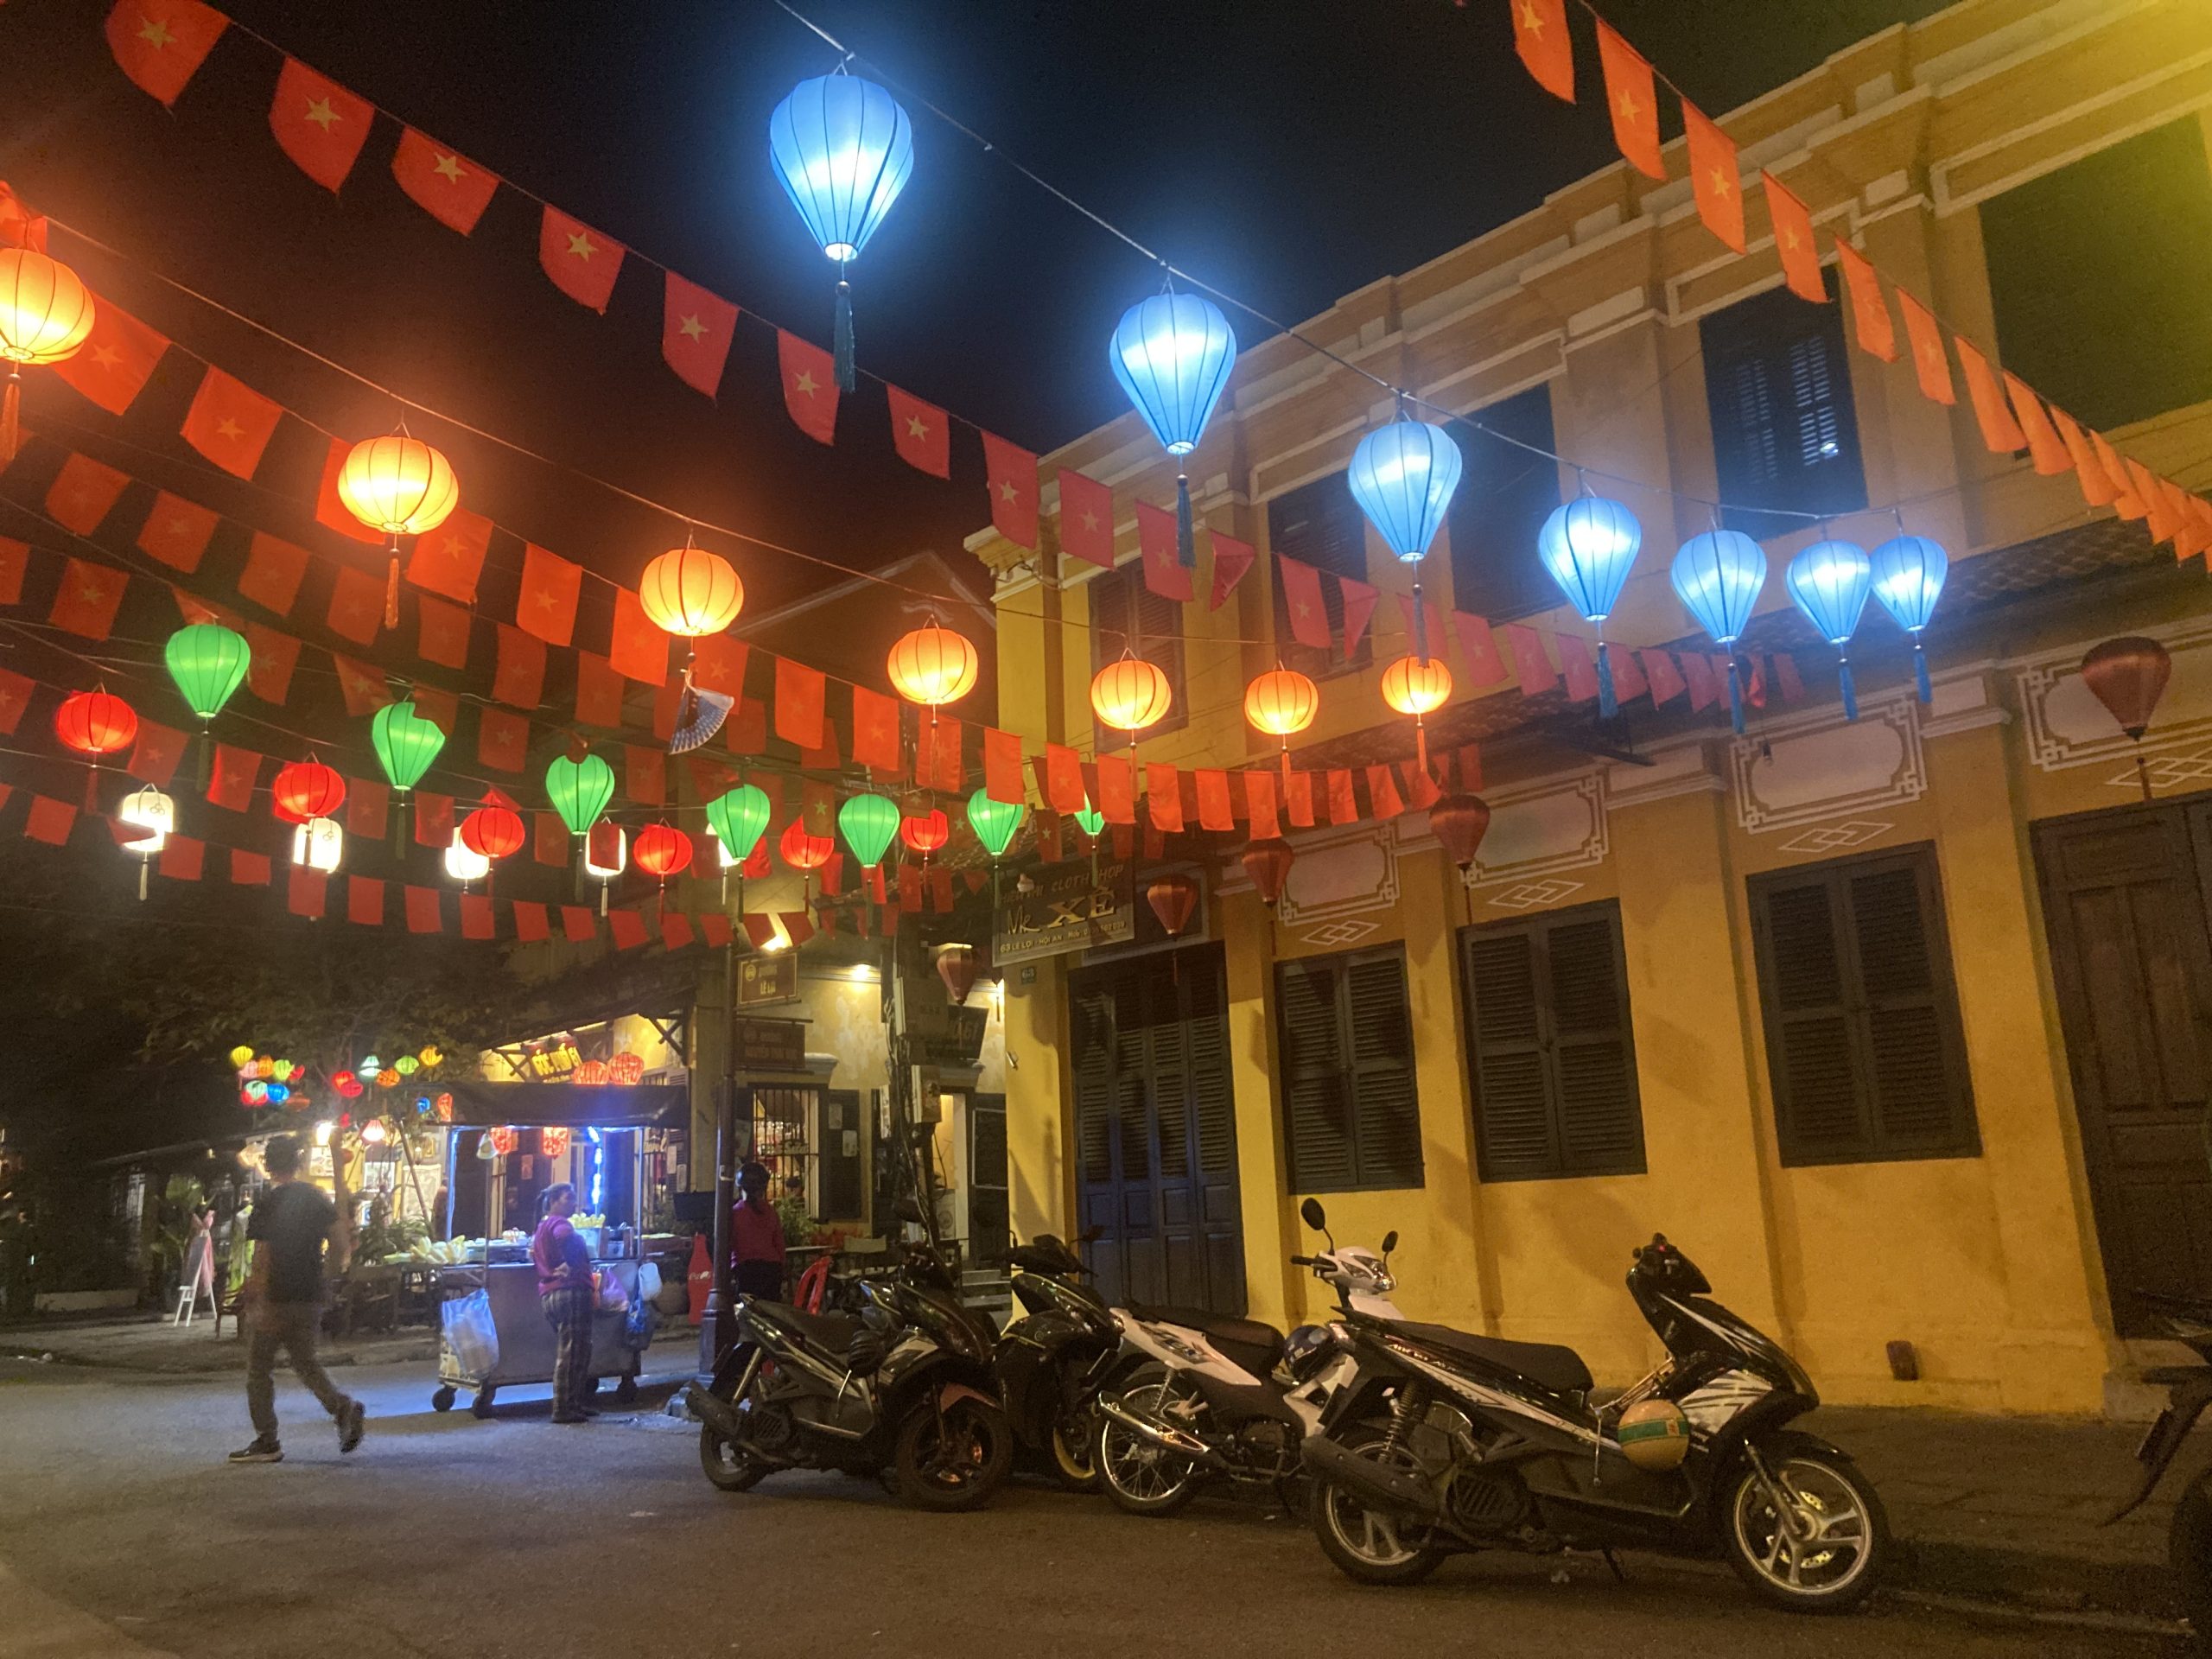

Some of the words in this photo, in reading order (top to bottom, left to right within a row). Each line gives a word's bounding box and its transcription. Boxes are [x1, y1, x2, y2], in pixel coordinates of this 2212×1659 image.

[1052, 873, 1090, 893] CLOTH
[1092, 864, 1124, 880] HOP
[1000, 943, 1011, 953] 63
